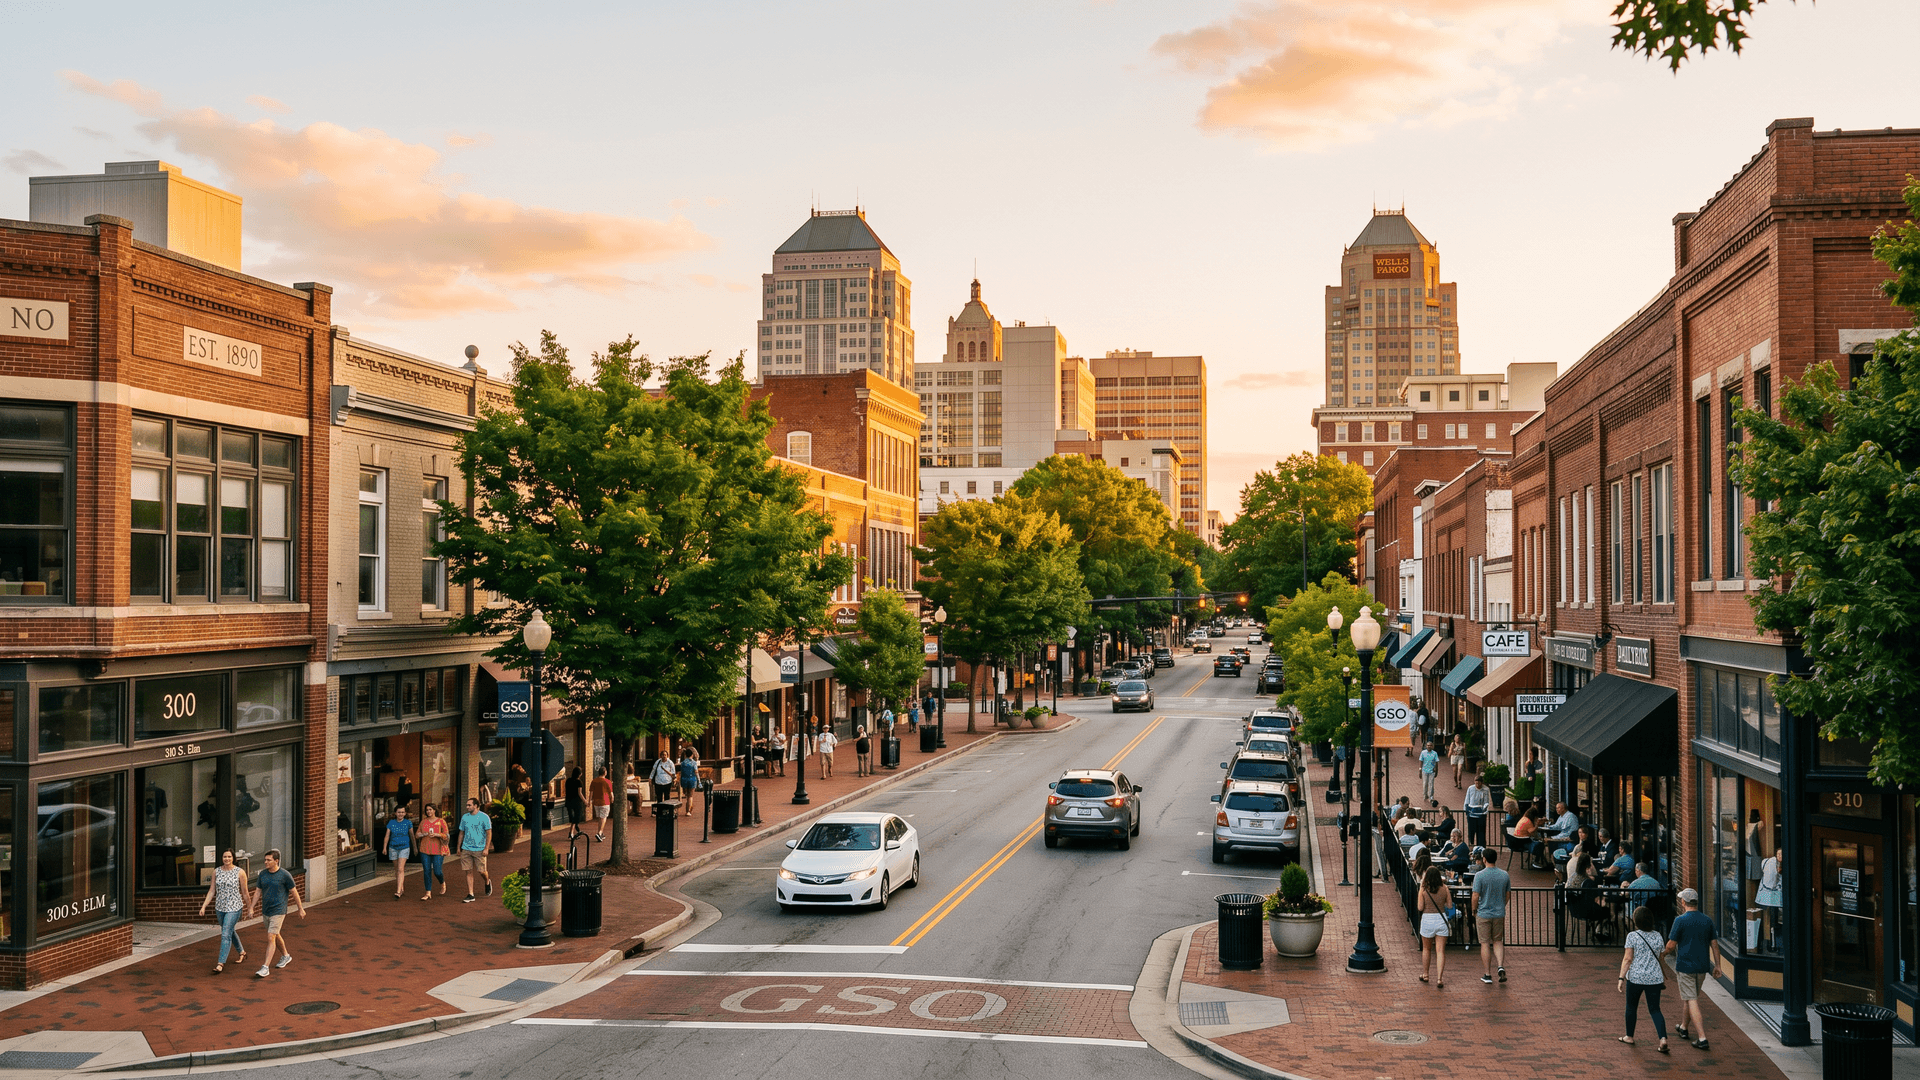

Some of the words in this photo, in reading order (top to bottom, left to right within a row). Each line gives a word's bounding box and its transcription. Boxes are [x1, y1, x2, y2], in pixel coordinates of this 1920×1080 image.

[1375, 257, 1409, 266] WELLS
[11, 307, 54, 331] NO
[188, 334, 219, 361] EST.
[227, 343, 259, 370] 1890
[163, 692, 196, 719] 300
[500, 701, 529, 713] GSO
[1376, 708, 1407, 719] GSO
[1833, 792, 1863, 808] 310
[46, 904, 69, 923] 300
[71, 901, 81, 916] S.
[82, 894, 106, 913] ELM
[720, 984, 1008, 1022] GSO
